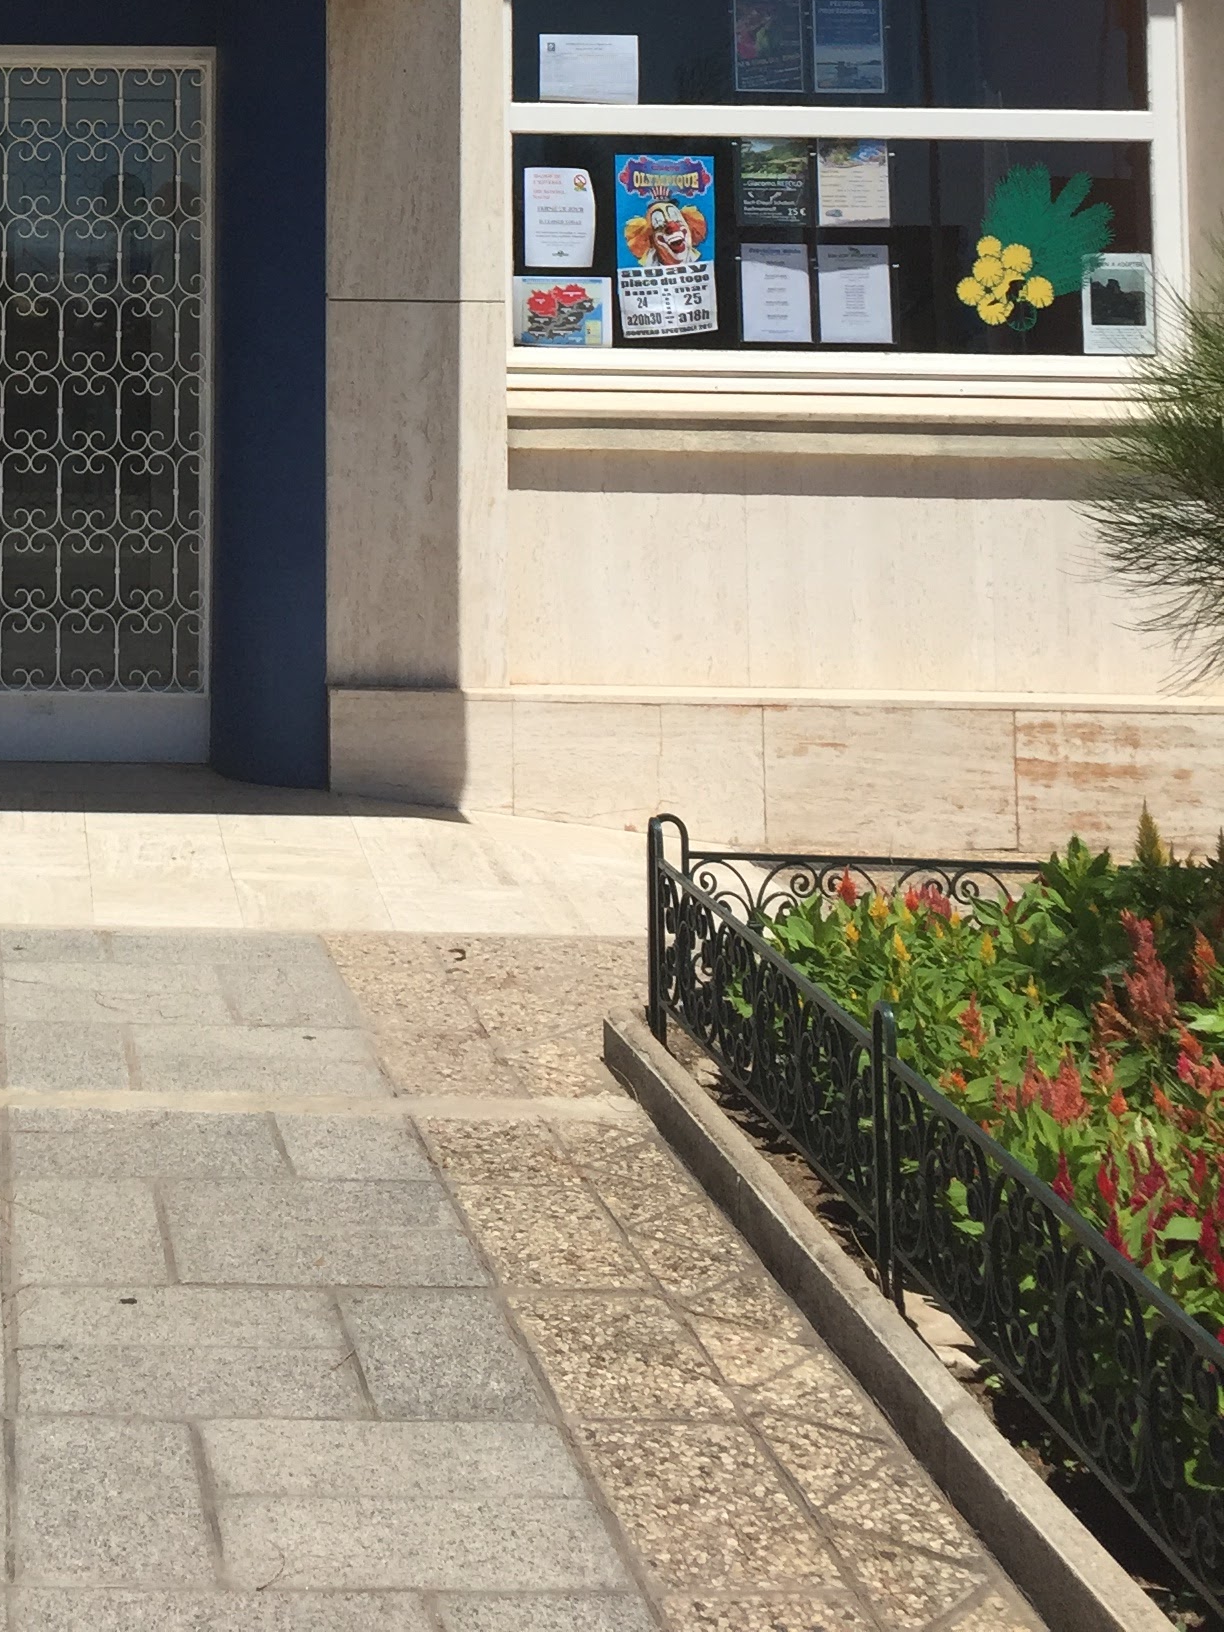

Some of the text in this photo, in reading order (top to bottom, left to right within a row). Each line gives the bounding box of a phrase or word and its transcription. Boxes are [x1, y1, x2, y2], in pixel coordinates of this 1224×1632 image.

[633, 171, 699, 189] OLYMPIQUE
[621, 279, 658, 288] place
[660, 277, 677, 286] du
[636, 292, 702, 309] 24 25
[627, 308, 711, 326] a20h30 a18h
